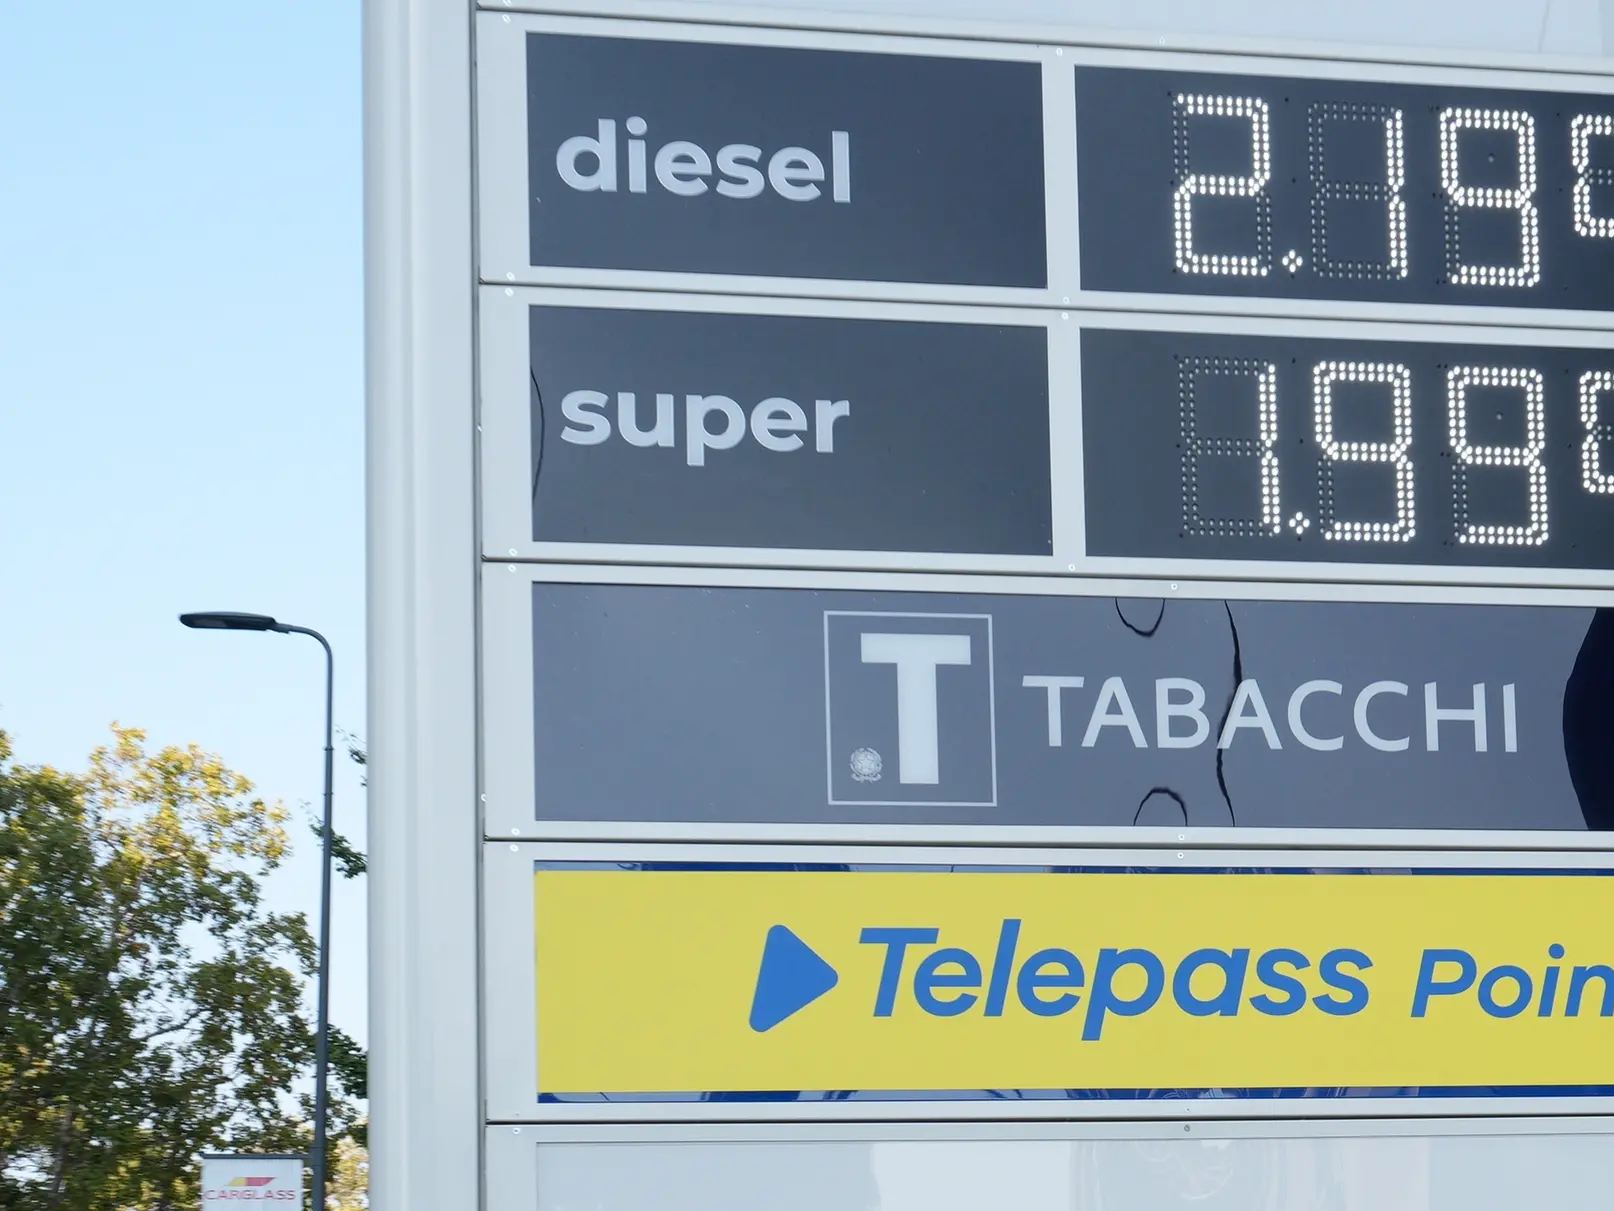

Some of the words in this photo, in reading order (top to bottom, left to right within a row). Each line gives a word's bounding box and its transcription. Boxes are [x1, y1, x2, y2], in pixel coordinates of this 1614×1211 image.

[555, 115, 852, 203] diesel
[560, 389, 852, 467] super
[1022, 675, 1519, 754] TABACCHI
[859, 918, 1373, 1042] Telepass
[204, 1189, 297, 1201] CARGLASS
